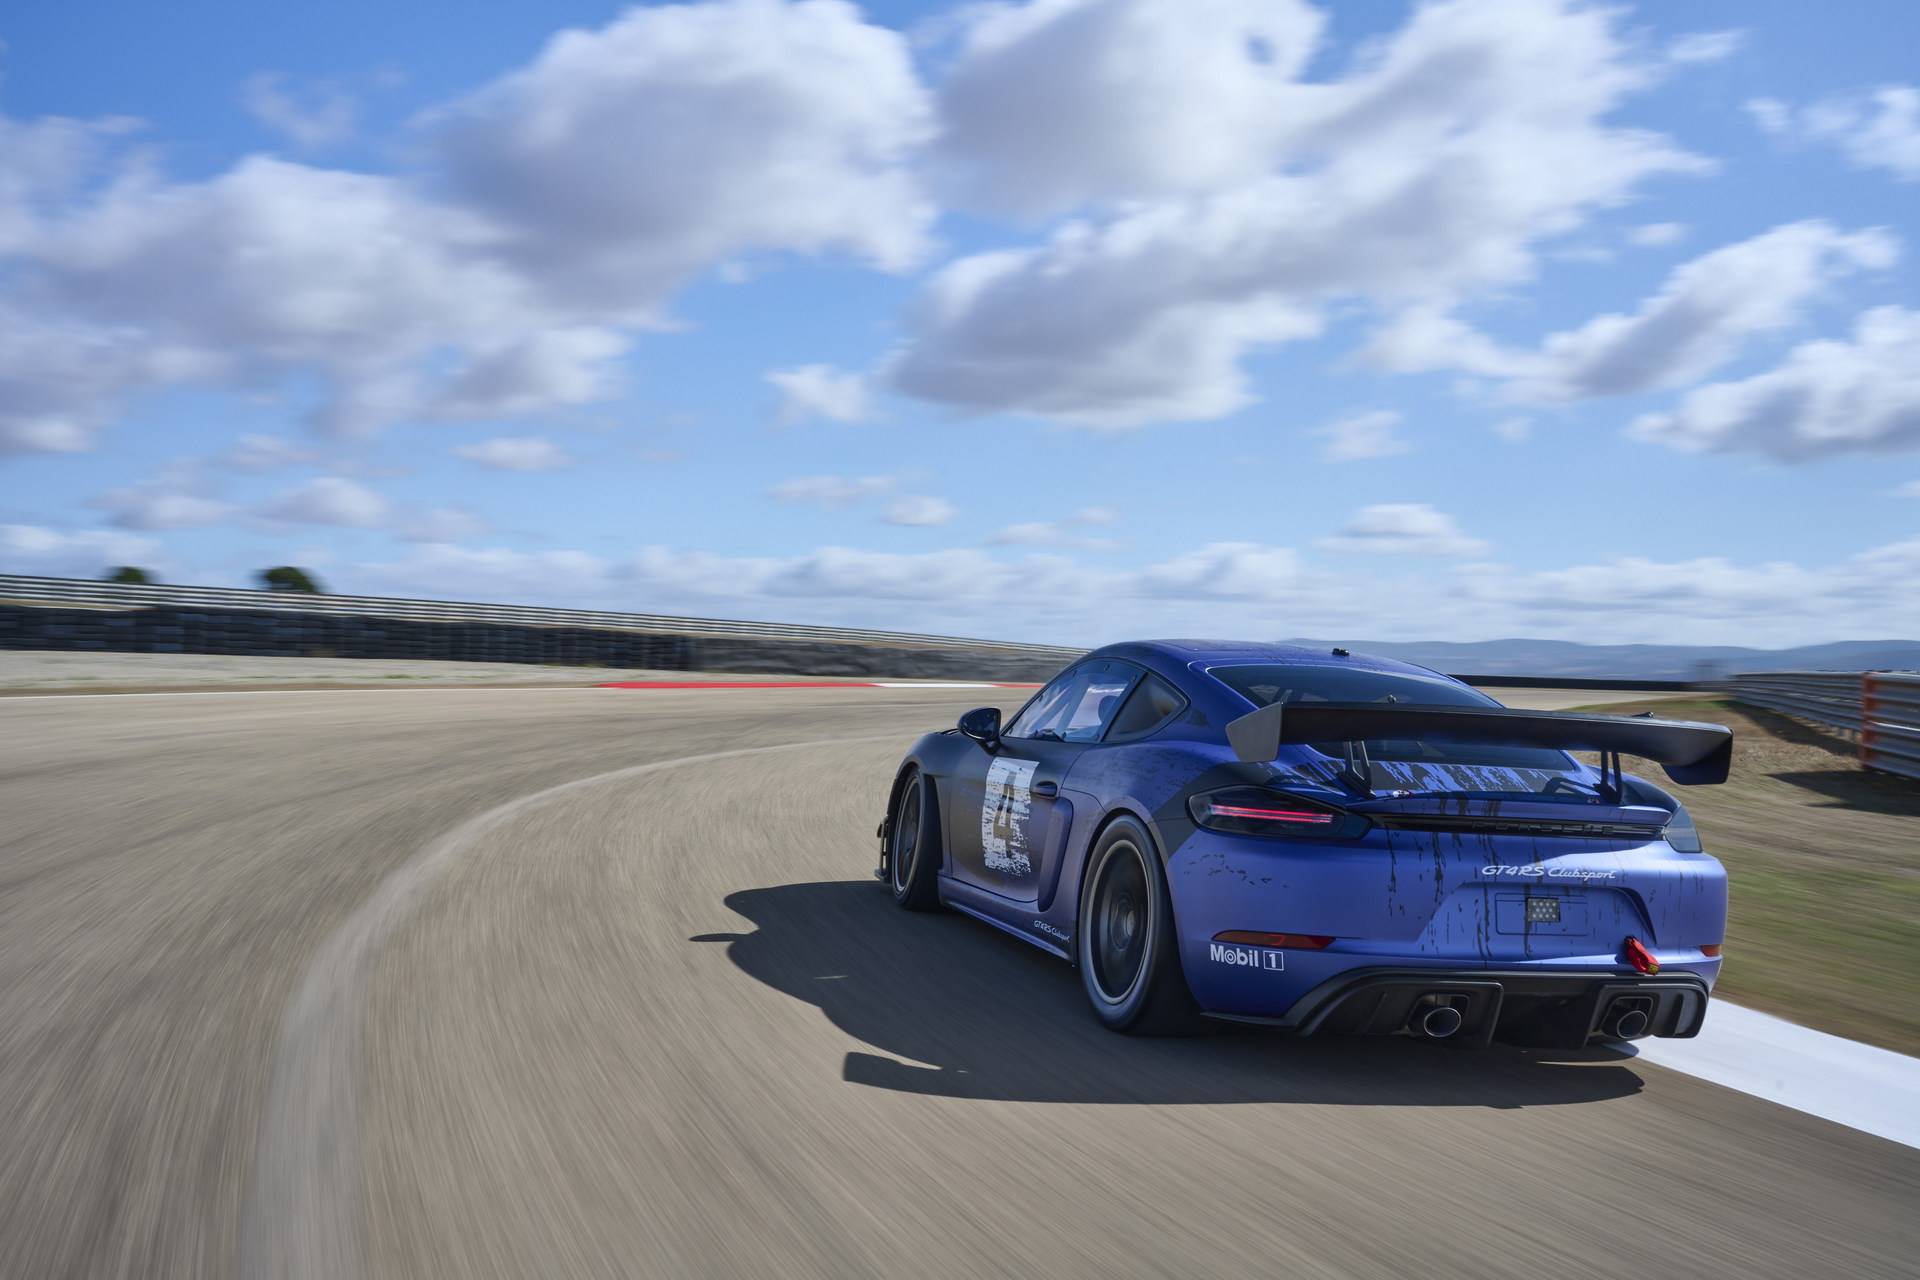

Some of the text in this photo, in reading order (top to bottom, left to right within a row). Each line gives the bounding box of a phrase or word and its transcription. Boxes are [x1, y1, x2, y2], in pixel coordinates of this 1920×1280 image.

[993, 771, 1017, 858] 4
[1472, 820, 1614, 835] PORSCHE
[1481, 865, 1617, 881] GT4RS Clubsport
[1210, 944, 1259, 967] Mobil
